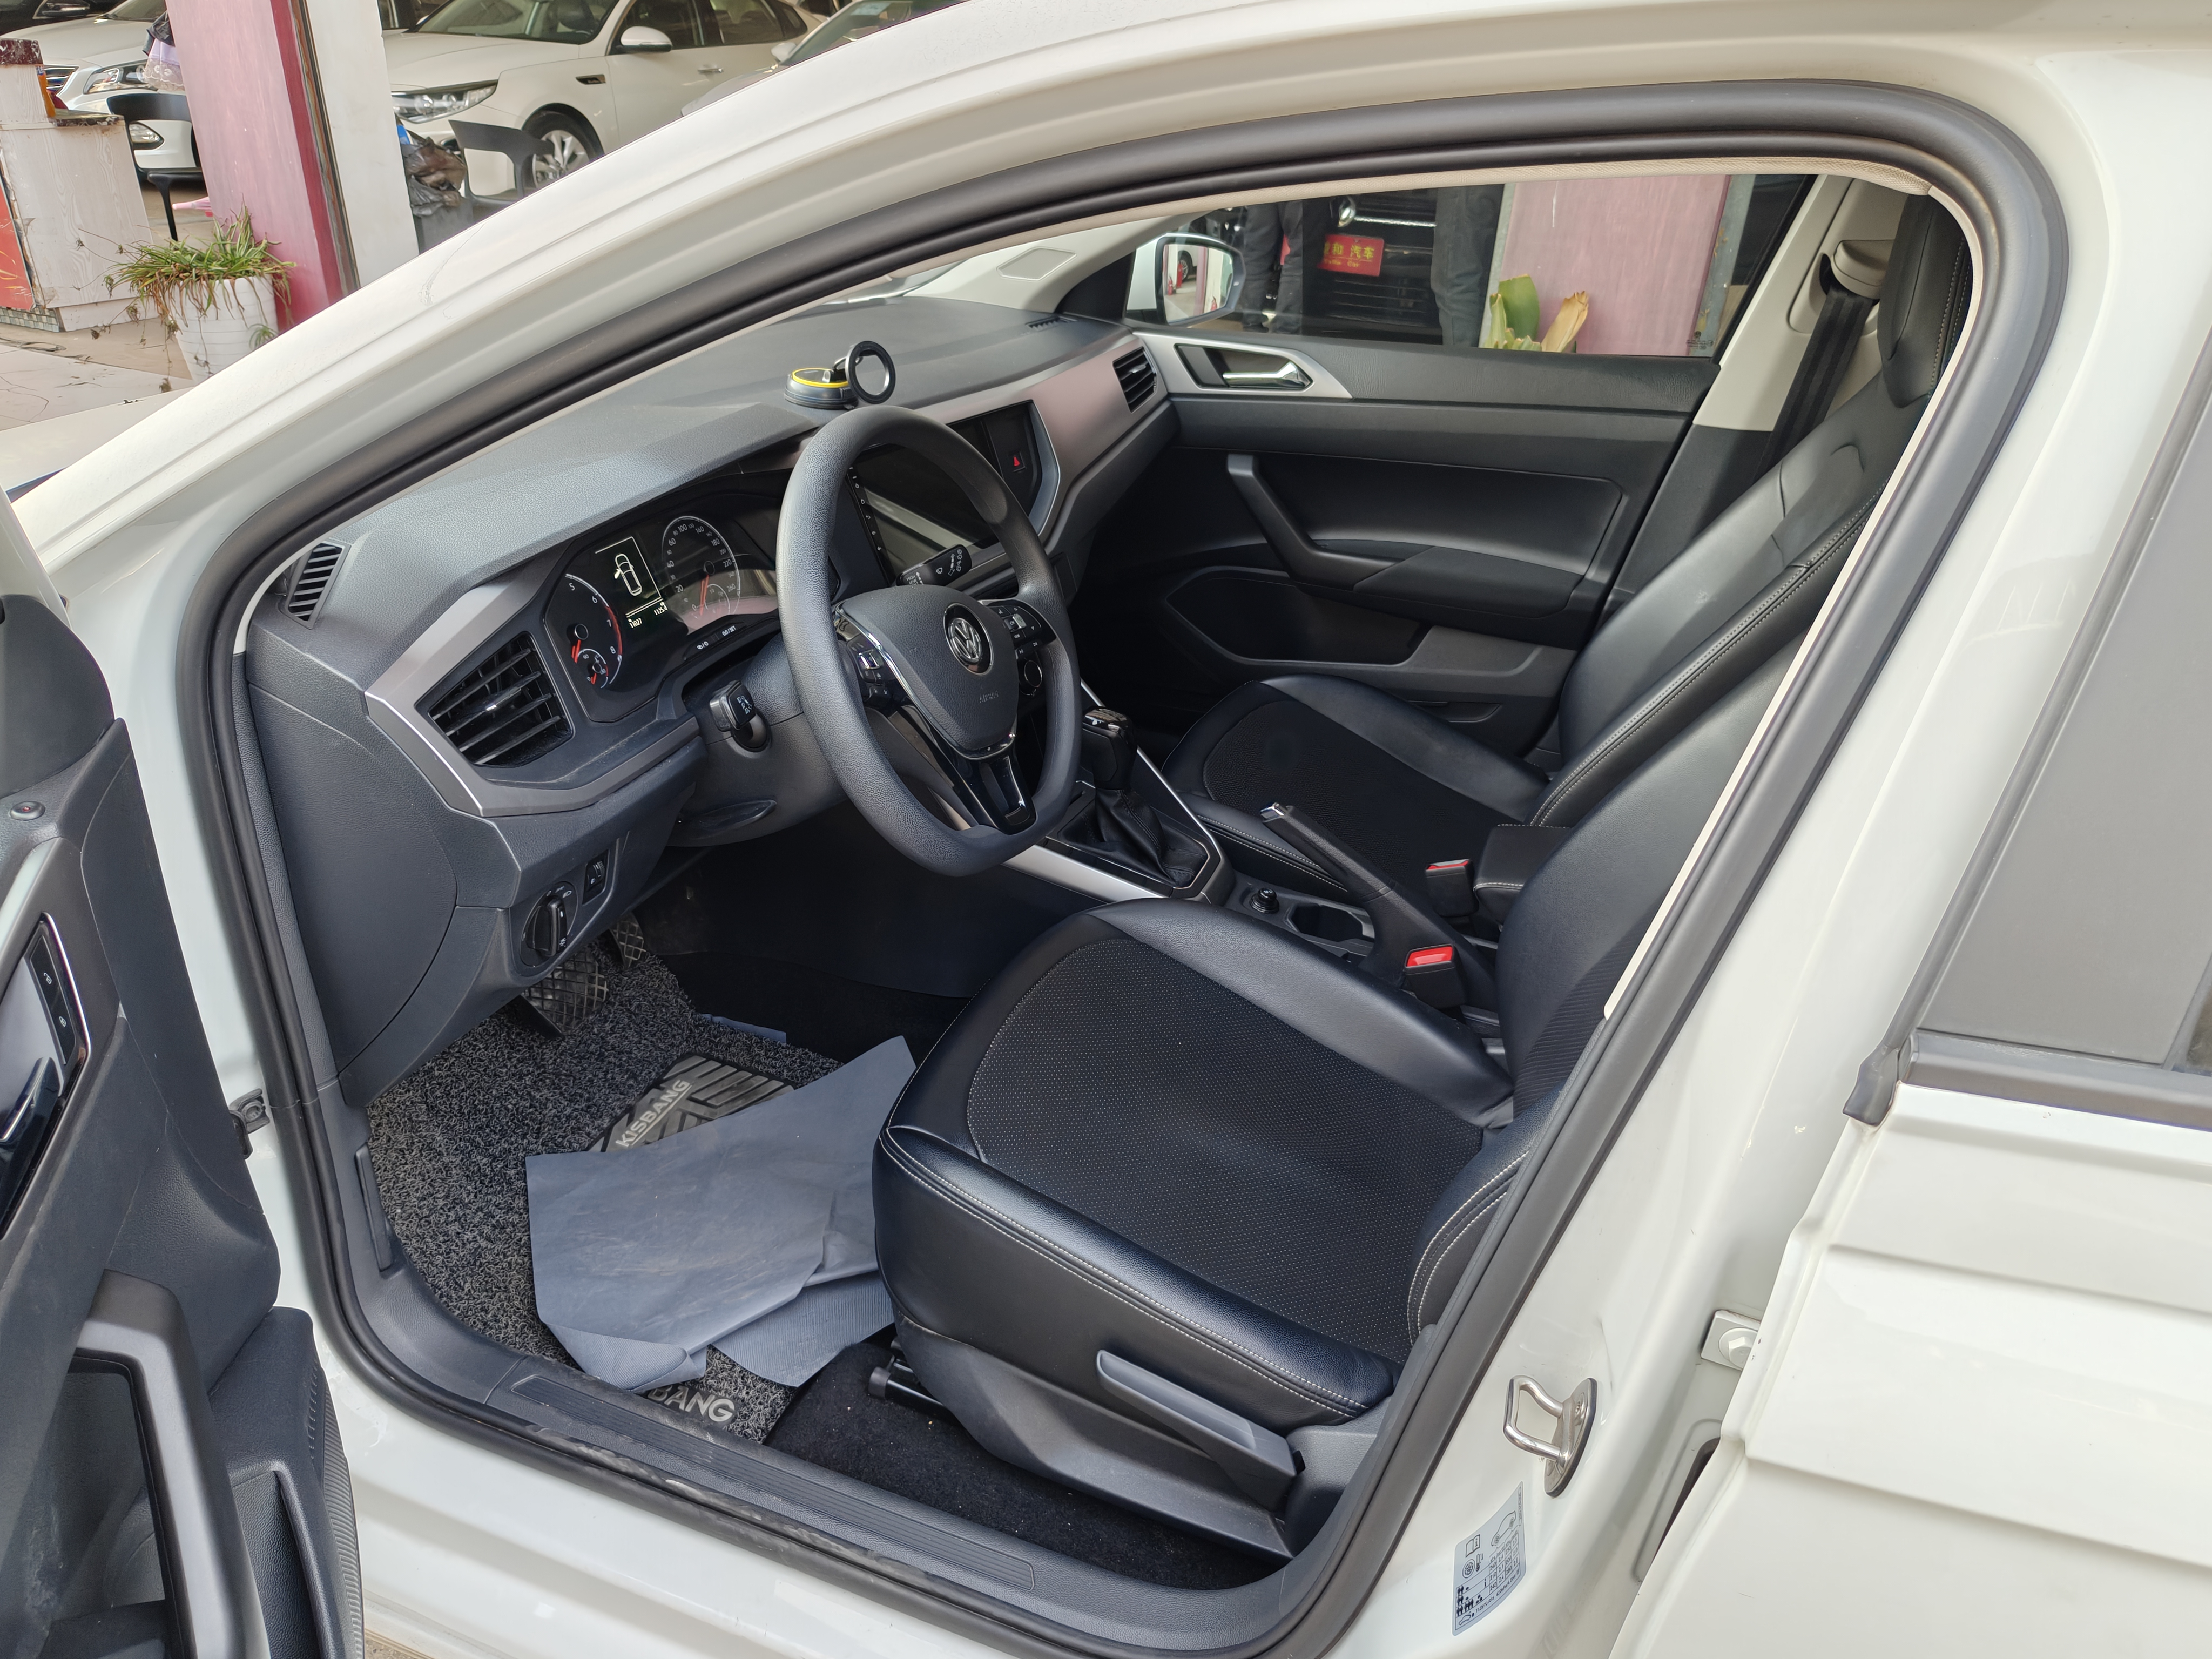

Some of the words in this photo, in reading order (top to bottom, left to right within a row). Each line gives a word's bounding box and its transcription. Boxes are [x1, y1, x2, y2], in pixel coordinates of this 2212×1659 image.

[678, 524, 687, 533] 100
[695, 526, 705, 534] 140
[669, 538, 676, 547] 60
[711, 538, 720, 547] 180
[666, 560, 675, 568] 40
[723, 559, 732, 568] 220
[569, 582, 575, 591] 5
[676, 584, 683, 593] 20
[726, 583, 736, 592] 260
[592, 596, 598, 604] 6
[610, 646, 616, 655] 8
[615, 1080, 690, 1147] KISBANG
